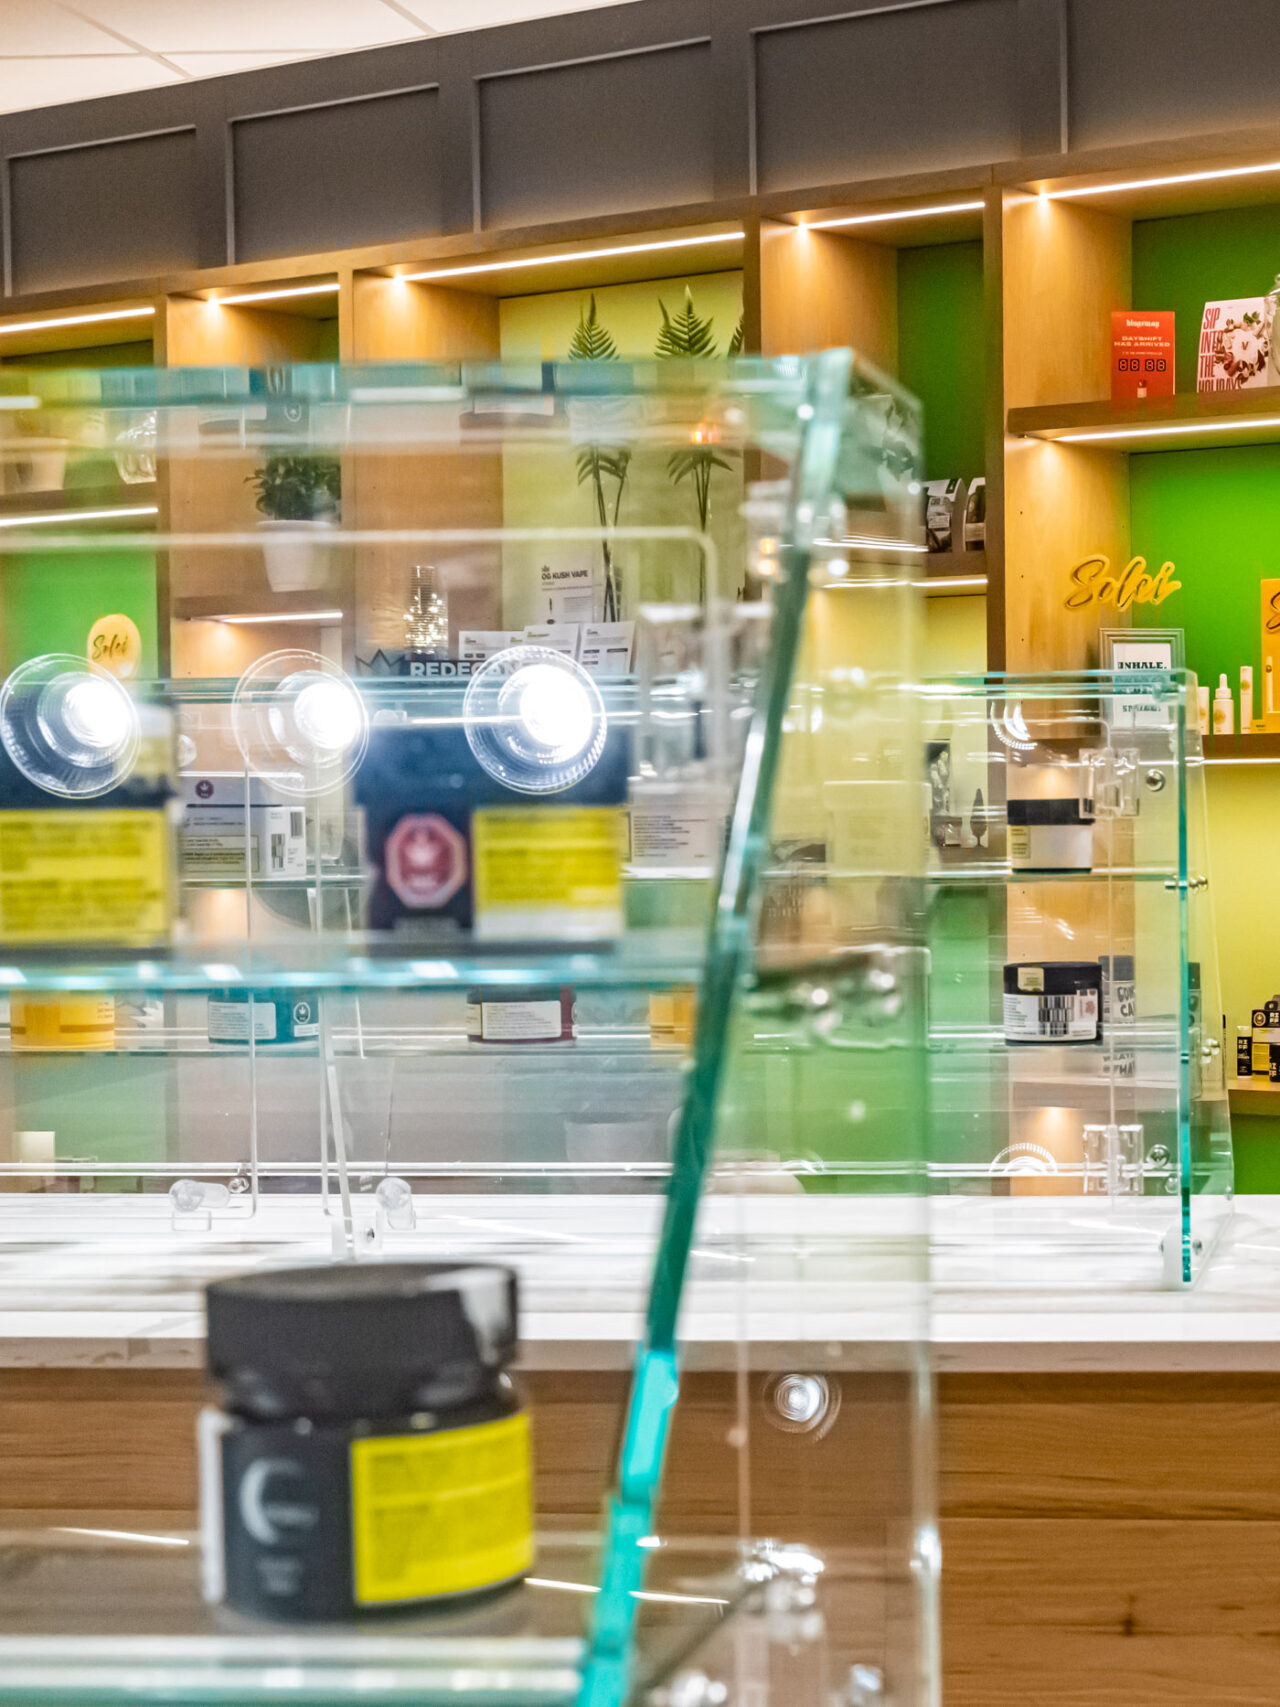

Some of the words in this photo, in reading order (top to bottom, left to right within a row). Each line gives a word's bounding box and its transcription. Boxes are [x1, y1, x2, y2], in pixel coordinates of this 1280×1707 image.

[1203, 308, 1221, 330] SIP
[1200, 354, 1217, 378] THE
[1065, 555, 1182, 611] Solei
